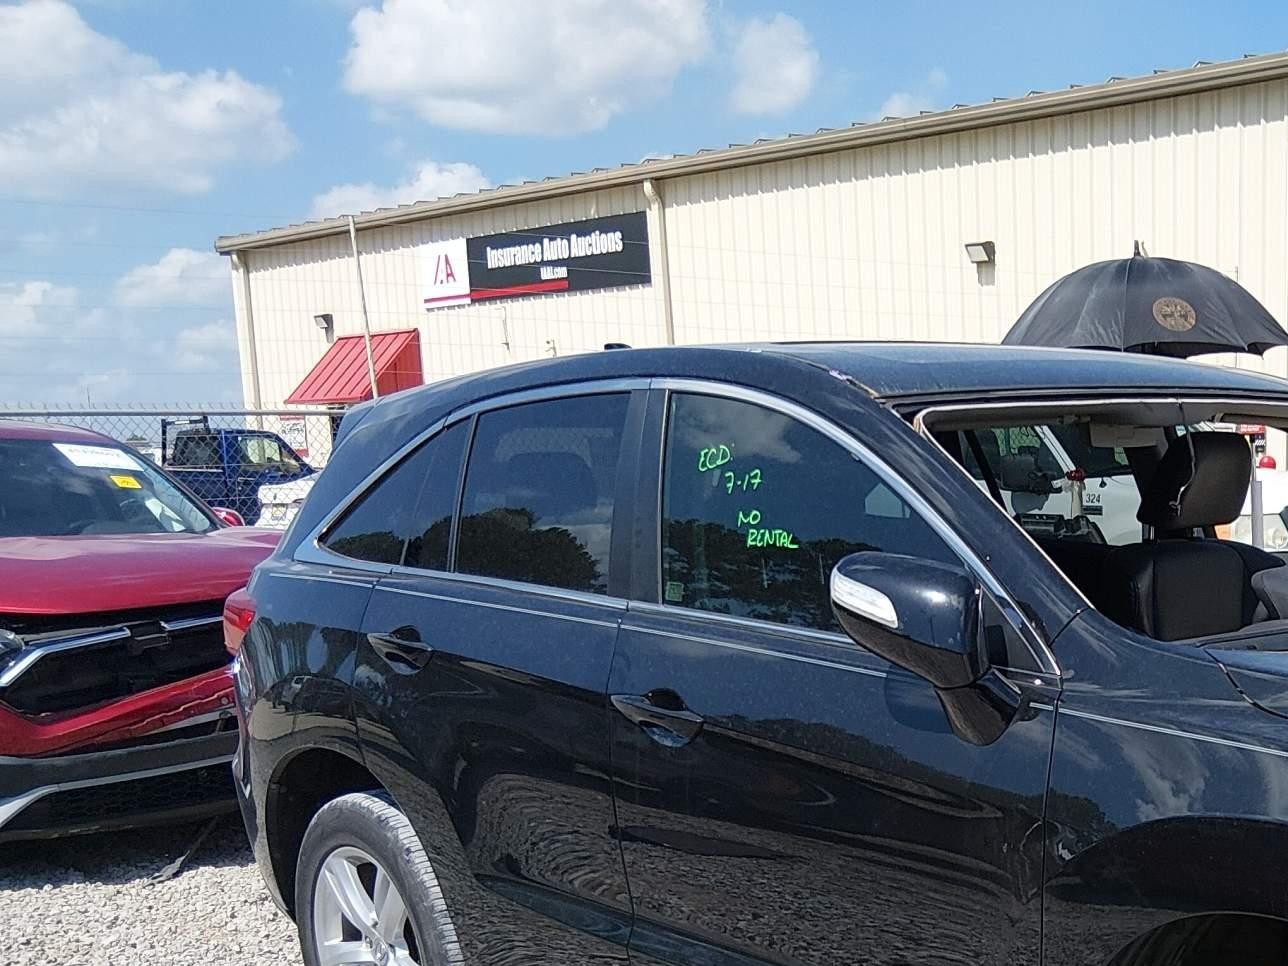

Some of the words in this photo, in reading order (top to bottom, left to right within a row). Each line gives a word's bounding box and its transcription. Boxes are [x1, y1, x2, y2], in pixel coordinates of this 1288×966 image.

[486, 243, 542, 269] Insurance
[543, 237, 570, 261] Auto
[570, 230, 623, 258] Auctions
[1085, 493, 1101, 504] 324
[737, 510, 761, 527] NO
[746, 529, 799, 549] RENTAL
